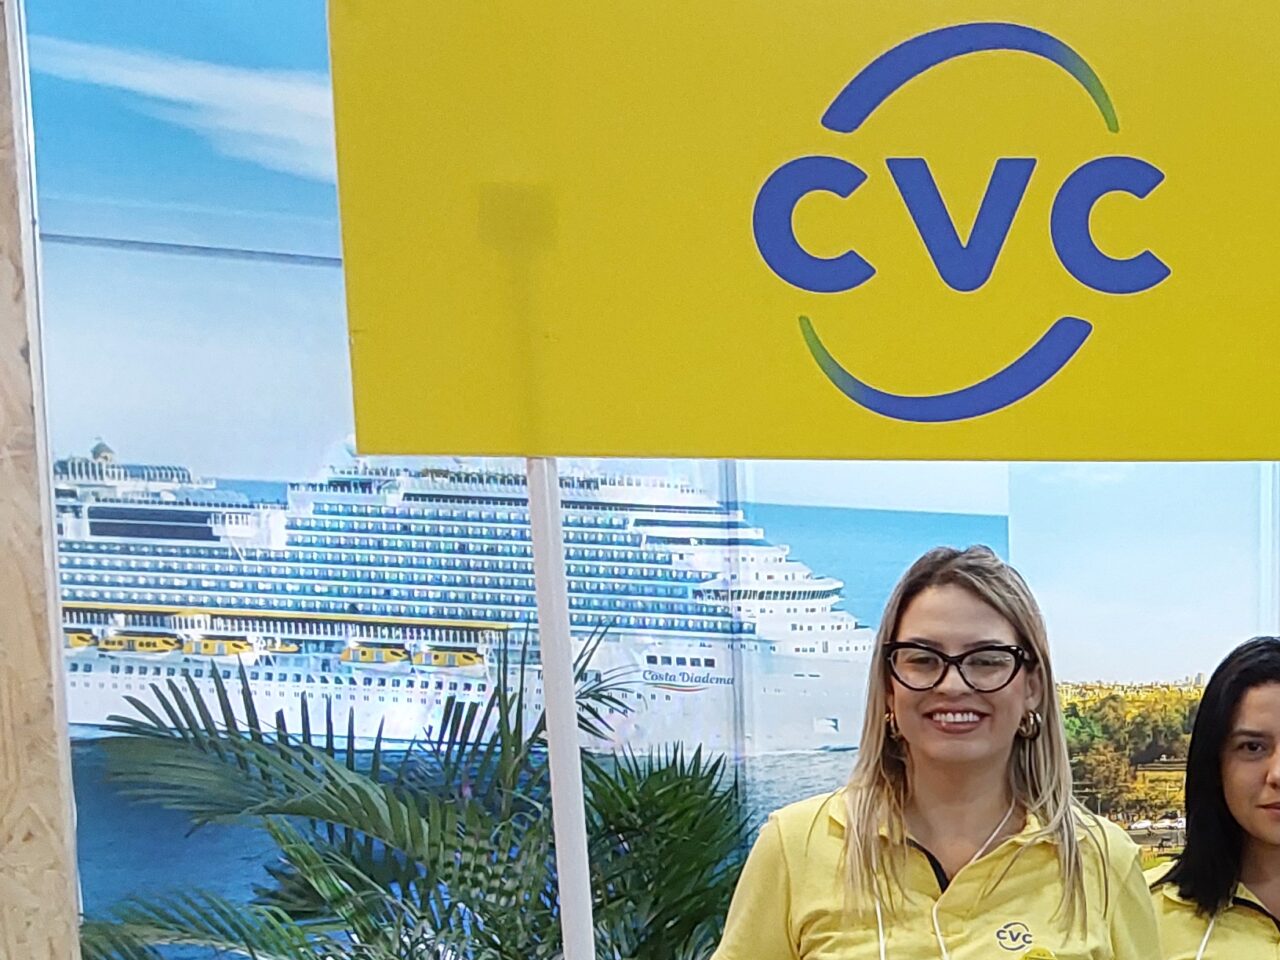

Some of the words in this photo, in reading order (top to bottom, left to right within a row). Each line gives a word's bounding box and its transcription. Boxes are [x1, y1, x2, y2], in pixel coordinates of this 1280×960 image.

[752, 155, 1172, 294] CVC
[642, 669, 677, 682] Costa
[679, 671, 735, 686] Diadema
[996, 929, 1033, 944] CVC
